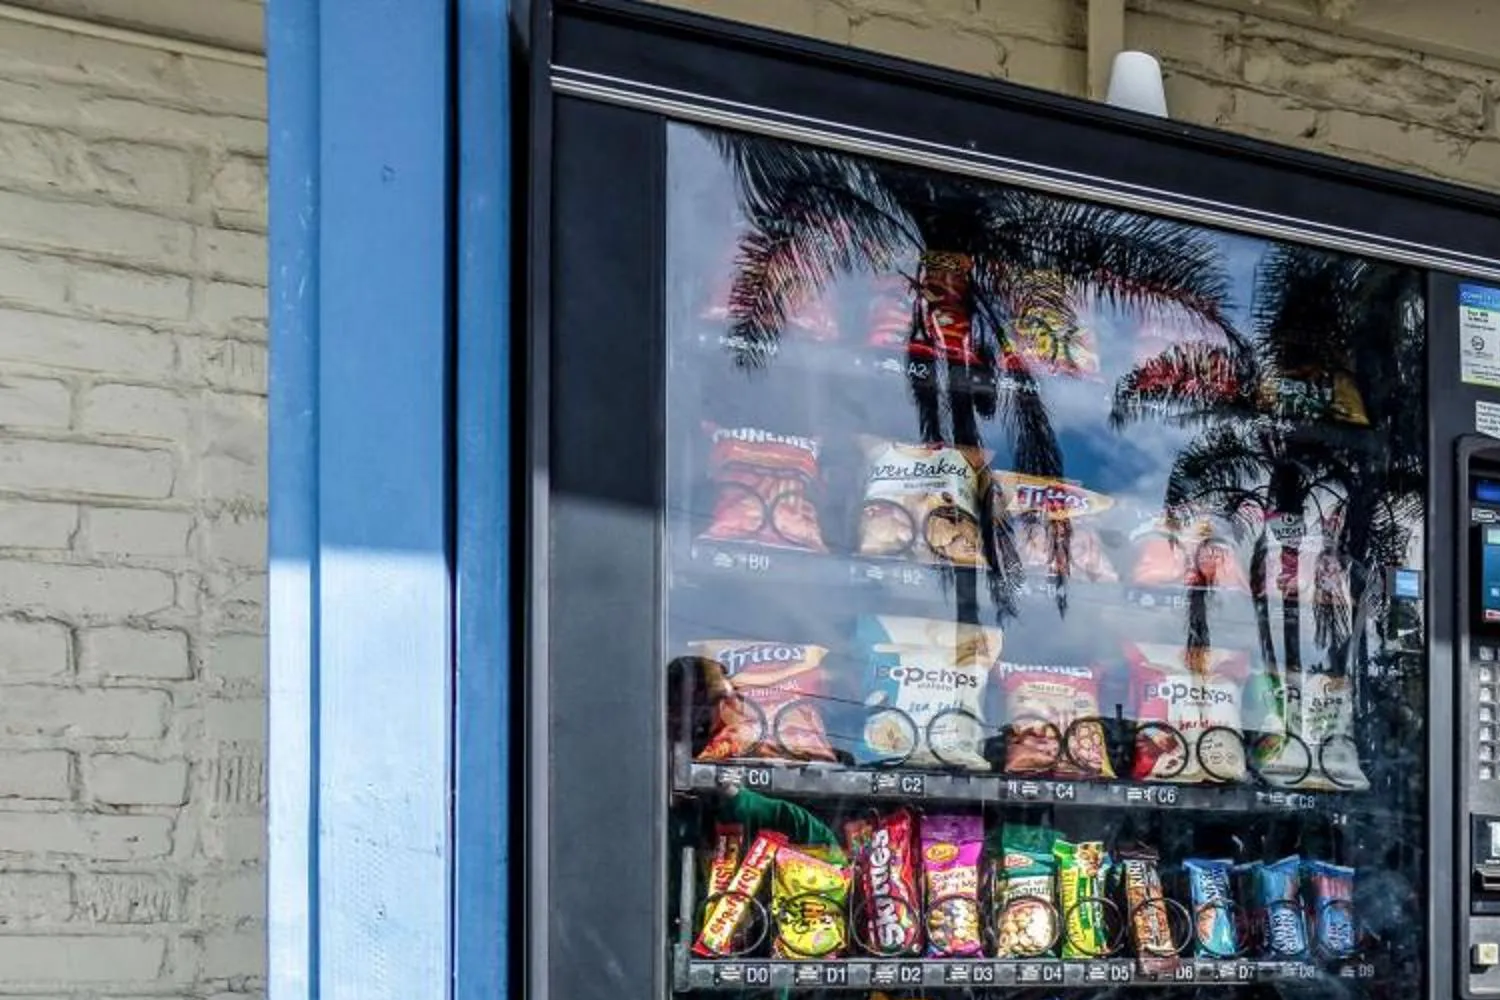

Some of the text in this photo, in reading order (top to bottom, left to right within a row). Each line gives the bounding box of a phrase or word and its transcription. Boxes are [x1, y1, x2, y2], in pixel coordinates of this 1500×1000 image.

[908, 364, 929, 378] A2
[914, 458, 971, 479] Baked
[716, 645, 804, 678] Fritos
[875, 665, 978, 689] popchips
[1144, 683, 1233, 704] popchips
[749, 771, 769, 786] C0
[902, 776, 922, 793] C2
[1055, 785, 1073, 798] C4
[1157, 788, 1176, 803] C6
[869, 828, 905, 947] Skittles
[747, 967, 769, 982] D0
[827, 967, 847, 982] D1
[901, 967, 921, 982] D2
[973, 966, 993, 981] D3
[1043, 965, 1062, 980] D4
[1111, 964, 1130, 980] D5
[1175, 965, 1193, 980] D6
[1239, 964, 1255, 979] D7
